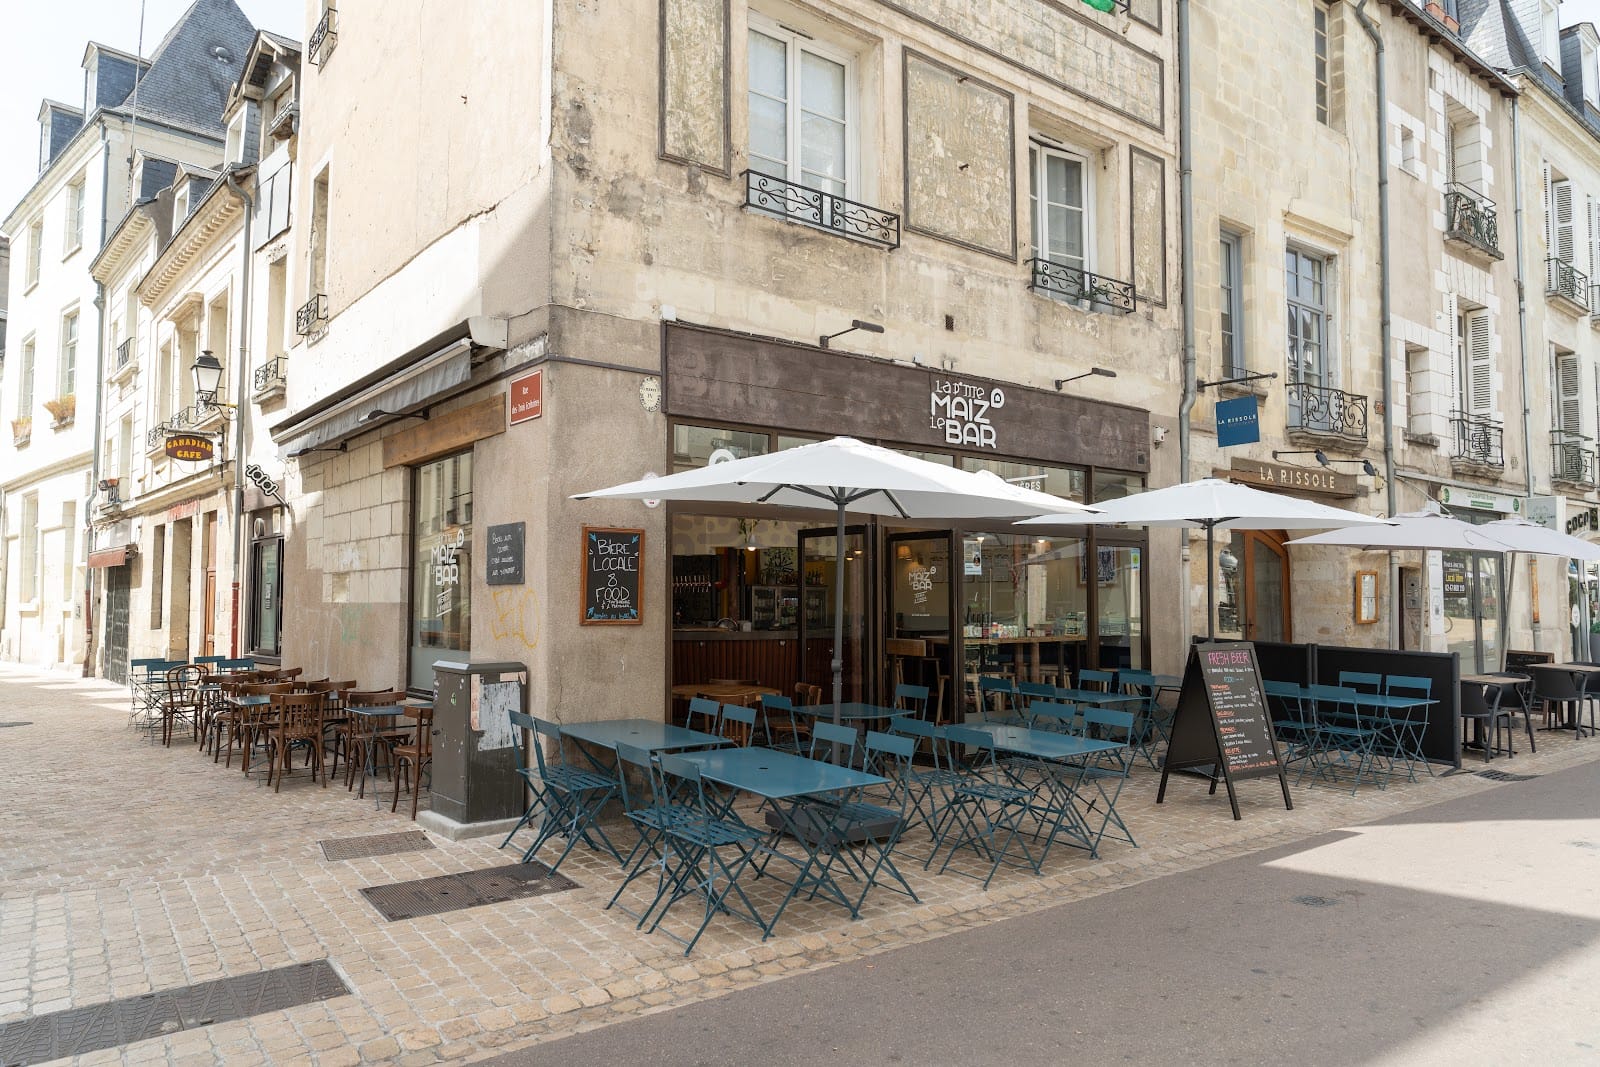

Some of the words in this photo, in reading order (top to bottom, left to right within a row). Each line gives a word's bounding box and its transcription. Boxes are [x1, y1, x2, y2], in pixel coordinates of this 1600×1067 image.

[931, 392, 990, 425] MAIZ
[1227, 414, 1256, 423] RISSOLE
[945, 419, 997, 449] BAR
[166, 438, 213, 452] CANADIAN
[176, 450, 202, 459] CAFE
[1260, 466, 1274, 482] LA
[1280, 469, 1335, 489] RISSOLE
[431, 542, 457, 566] MAIZ
[592, 556, 638, 571] LOCALE
[435, 564, 459, 586] BAR
[912, 580, 933, 591] BAR
[595, 586, 630, 603] FOOD
[1208, 652, 1230, 665] FRESH
[1230, 652, 1249, 664] BEER
